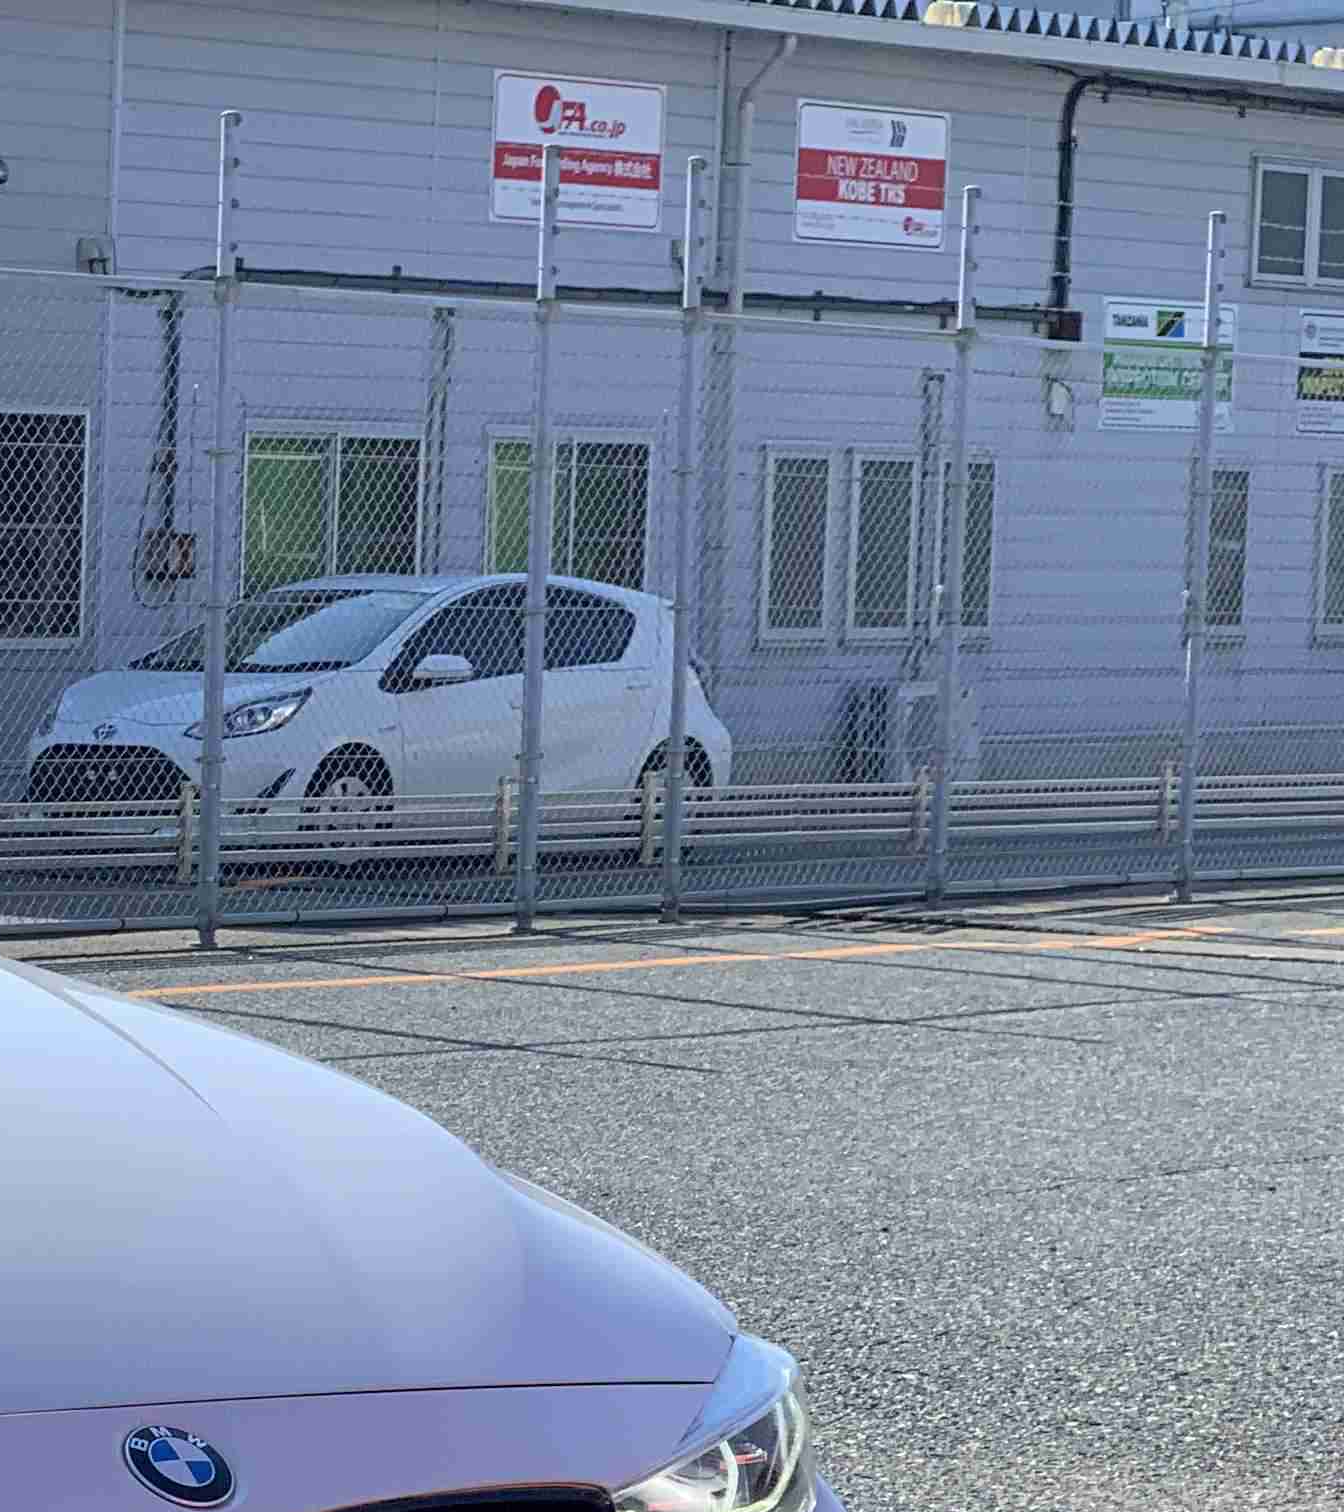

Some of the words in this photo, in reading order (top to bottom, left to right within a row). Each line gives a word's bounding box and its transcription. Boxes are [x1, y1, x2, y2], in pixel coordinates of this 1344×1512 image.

[827, 154, 857, 177] NEW
[858, 157, 919, 182] ZEALAND
[837, 179, 875, 202] KOBE
